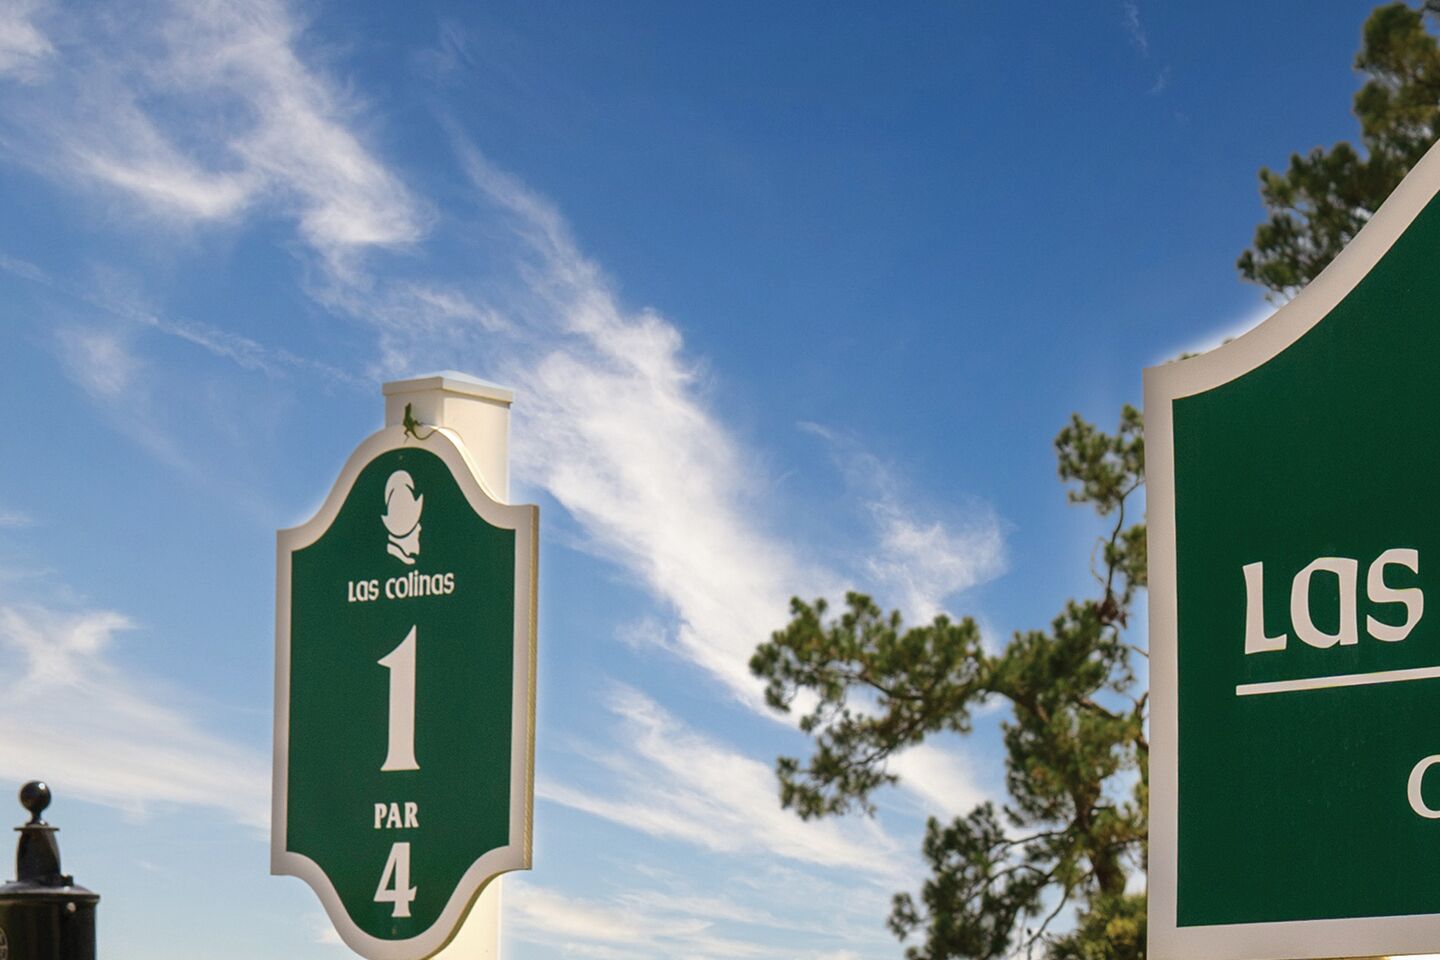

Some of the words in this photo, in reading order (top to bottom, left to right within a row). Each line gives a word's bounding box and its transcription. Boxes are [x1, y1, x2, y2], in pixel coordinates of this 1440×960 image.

[378, 625, 420, 771] 1
[374, 802, 419, 829] PAR
[374, 842, 417, 917] 4
